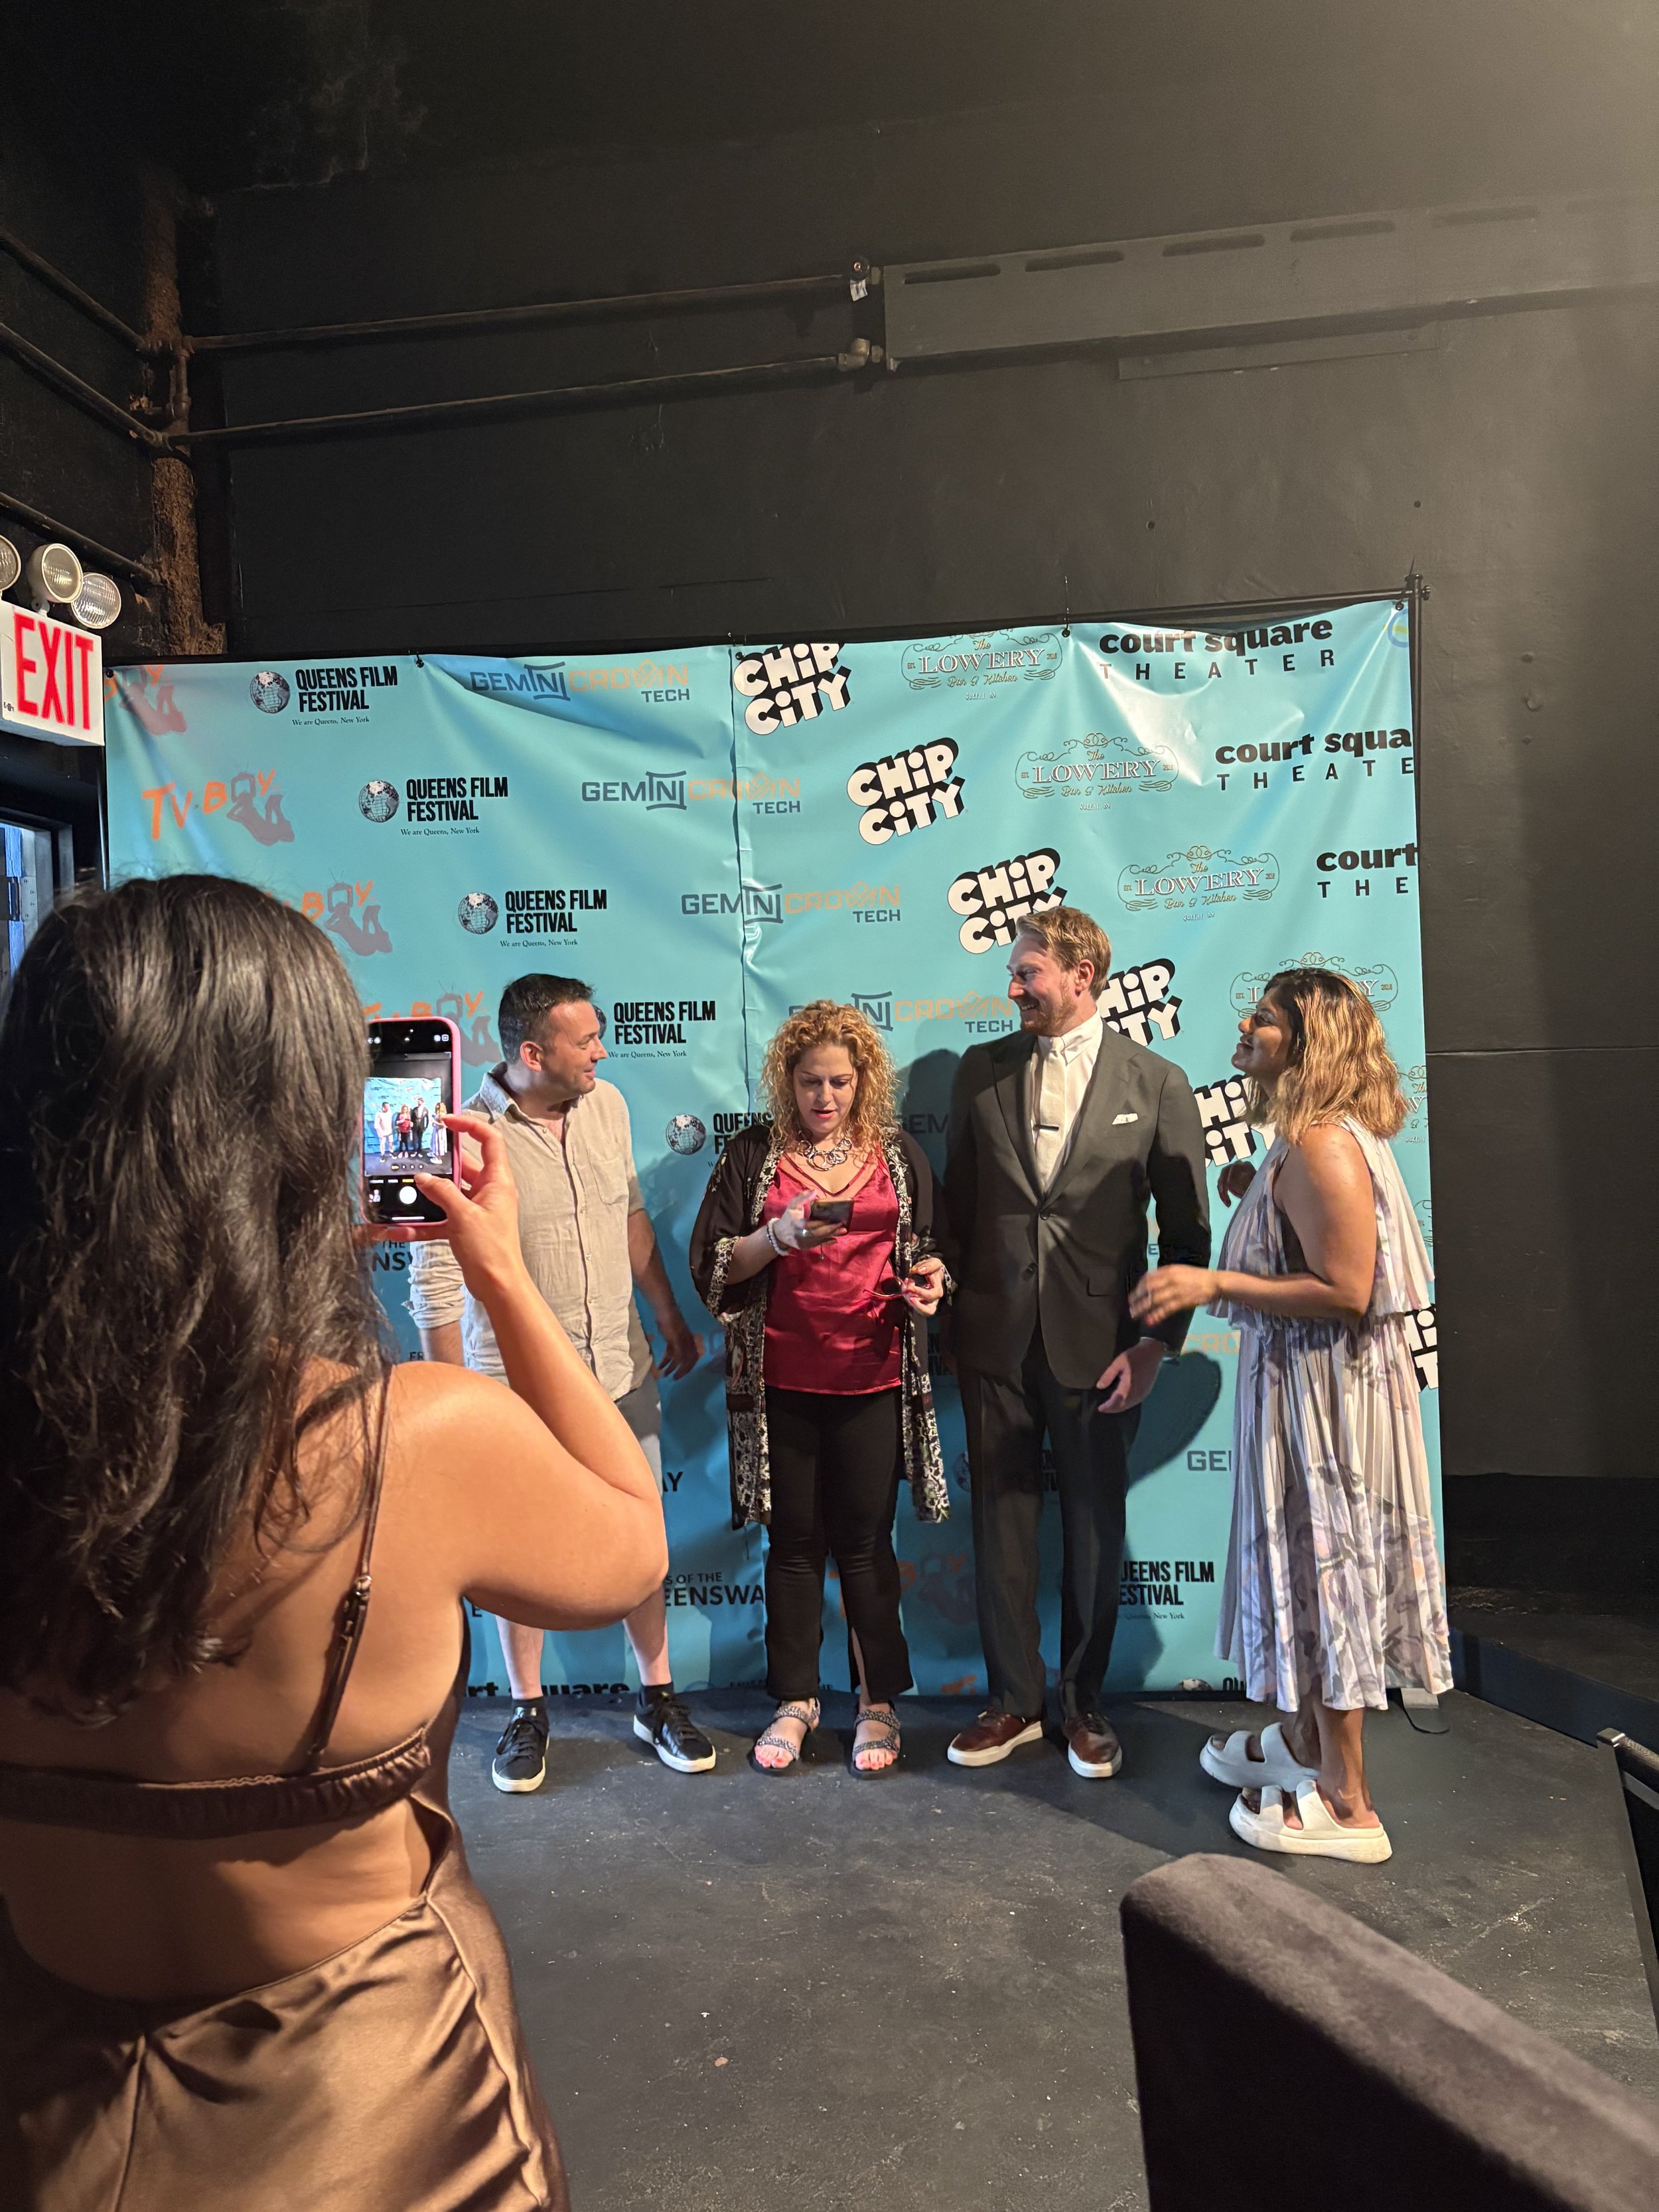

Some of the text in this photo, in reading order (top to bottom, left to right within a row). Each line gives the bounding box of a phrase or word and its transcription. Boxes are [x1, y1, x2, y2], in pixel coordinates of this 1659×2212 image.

[1100, 620, 1333, 656] court square
[14, 612, 94, 730] EXIT
[918, 648, 1045, 674] LOWERY
[1100, 649, 1334, 680] THEATER
[295, 666, 397, 691] QUEENS FILM
[470, 662, 571, 701] GEMINI
[299, 690, 369, 712] FESTIVAL
[641, 689, 689, 703] TECH
[1215, 729, 1412, 764] court squa
[1033, 760, 1161, 783] LOWERY
[1217, 757, 1413, 790] THEATE
[406, 777, 508, 801] QUEENS FILM
[582, 771, 687, 811] GEMINI
[407, 800, 478, 822] FESTIVAL
[753, 801, 800, 814] TECH
[1317, 843, 1418, 871] court
[1135, 868, 1264, 895] LOWERY
[505, 889, 607, 913] QUEENS FILM
[682, 883, 784, 924] GEMINI
[506, 913, 577, 933] FESTIVAL
[853, 909, 901, 923] TECH
[614, 1001, 715, 1023] QUEENS FILM
[614, 1024, 686, 1045] FESTIVAL
[965, 1020, 1013, 1033] TECH
[676, 1574, 693, 1584] OF
[697, 1572, 722, 1582] THE
[1175, 1562, 1214, 1582] FILM
[1120, 1584, 1184, 1605] ESTIVAL
